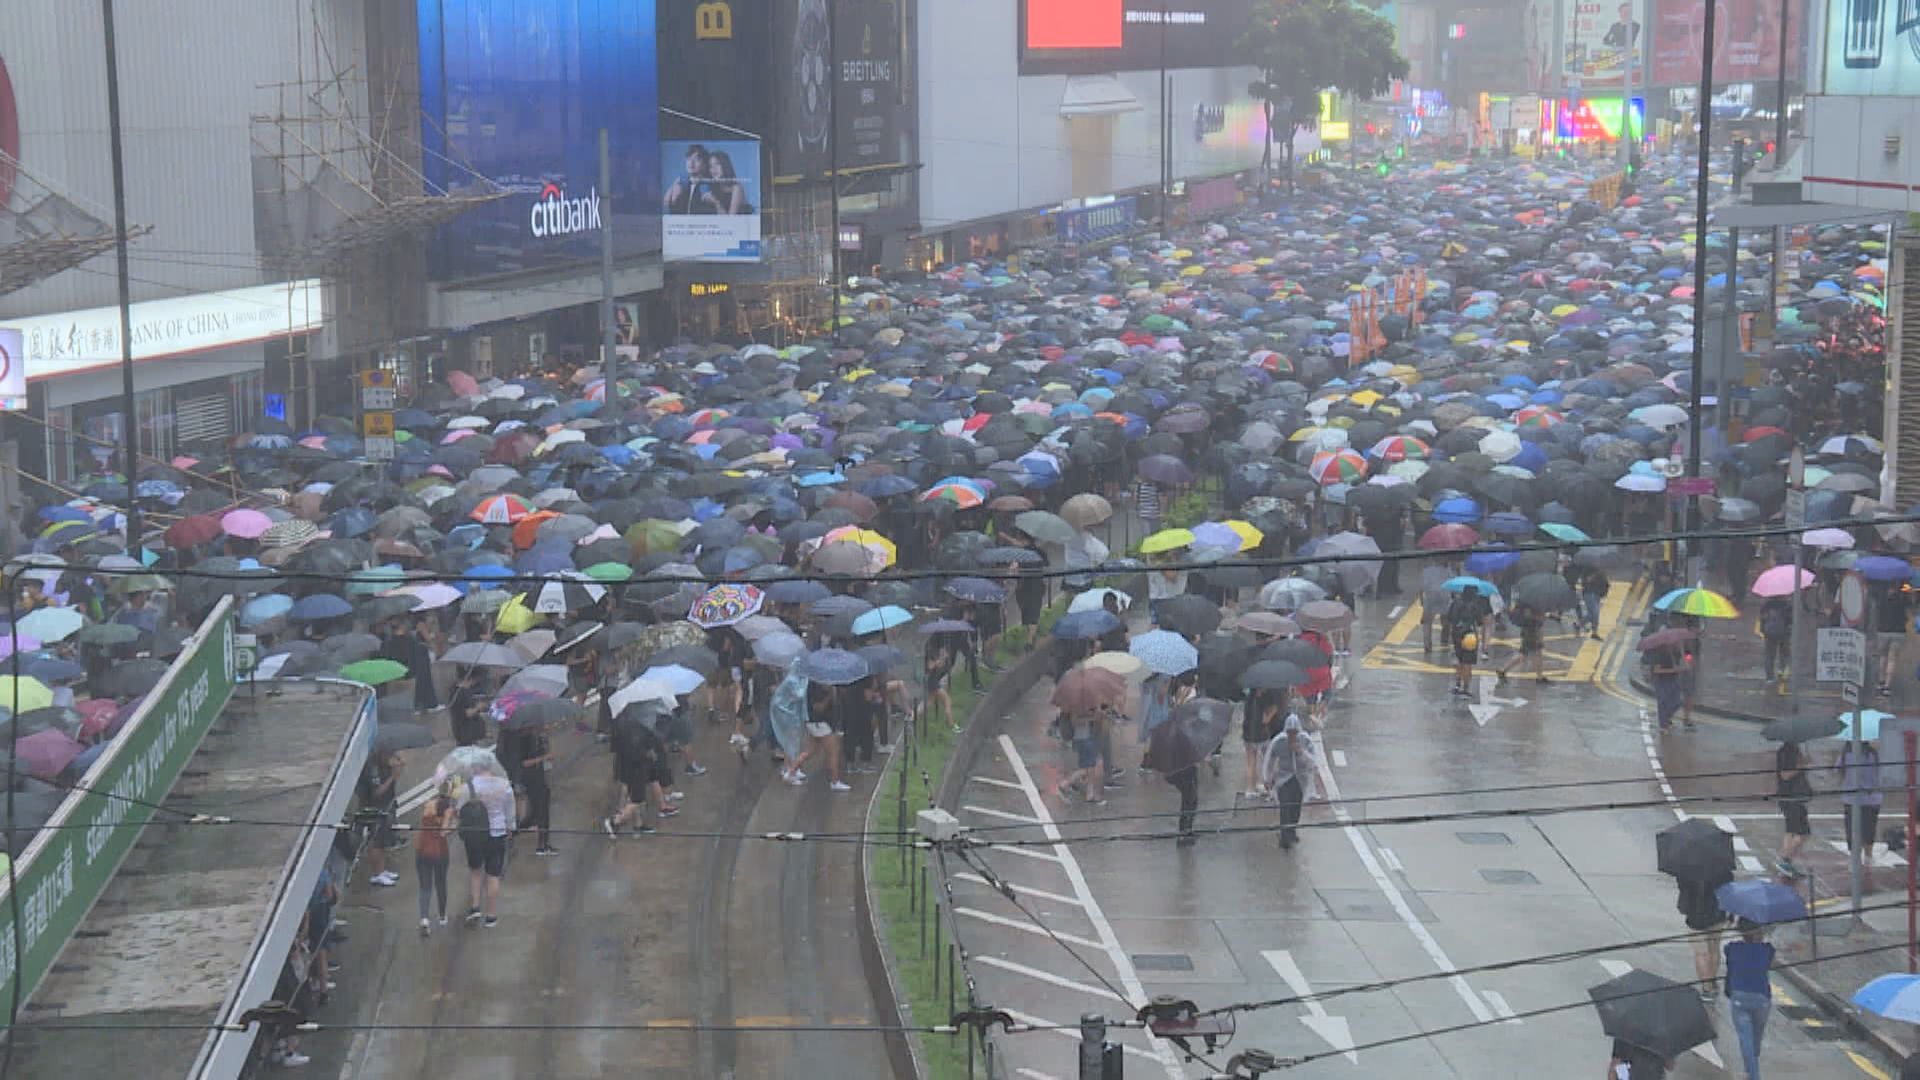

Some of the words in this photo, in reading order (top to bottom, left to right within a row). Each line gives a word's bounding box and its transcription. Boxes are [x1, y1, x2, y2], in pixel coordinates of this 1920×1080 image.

[843, 61, 890, 82] BREITLING
[531, 184, 602, 238] citibank
[130, 320, 161, 347] ANK
[166, 318, 183, 338] OF
[187, 311, 230, 336] CHINA
